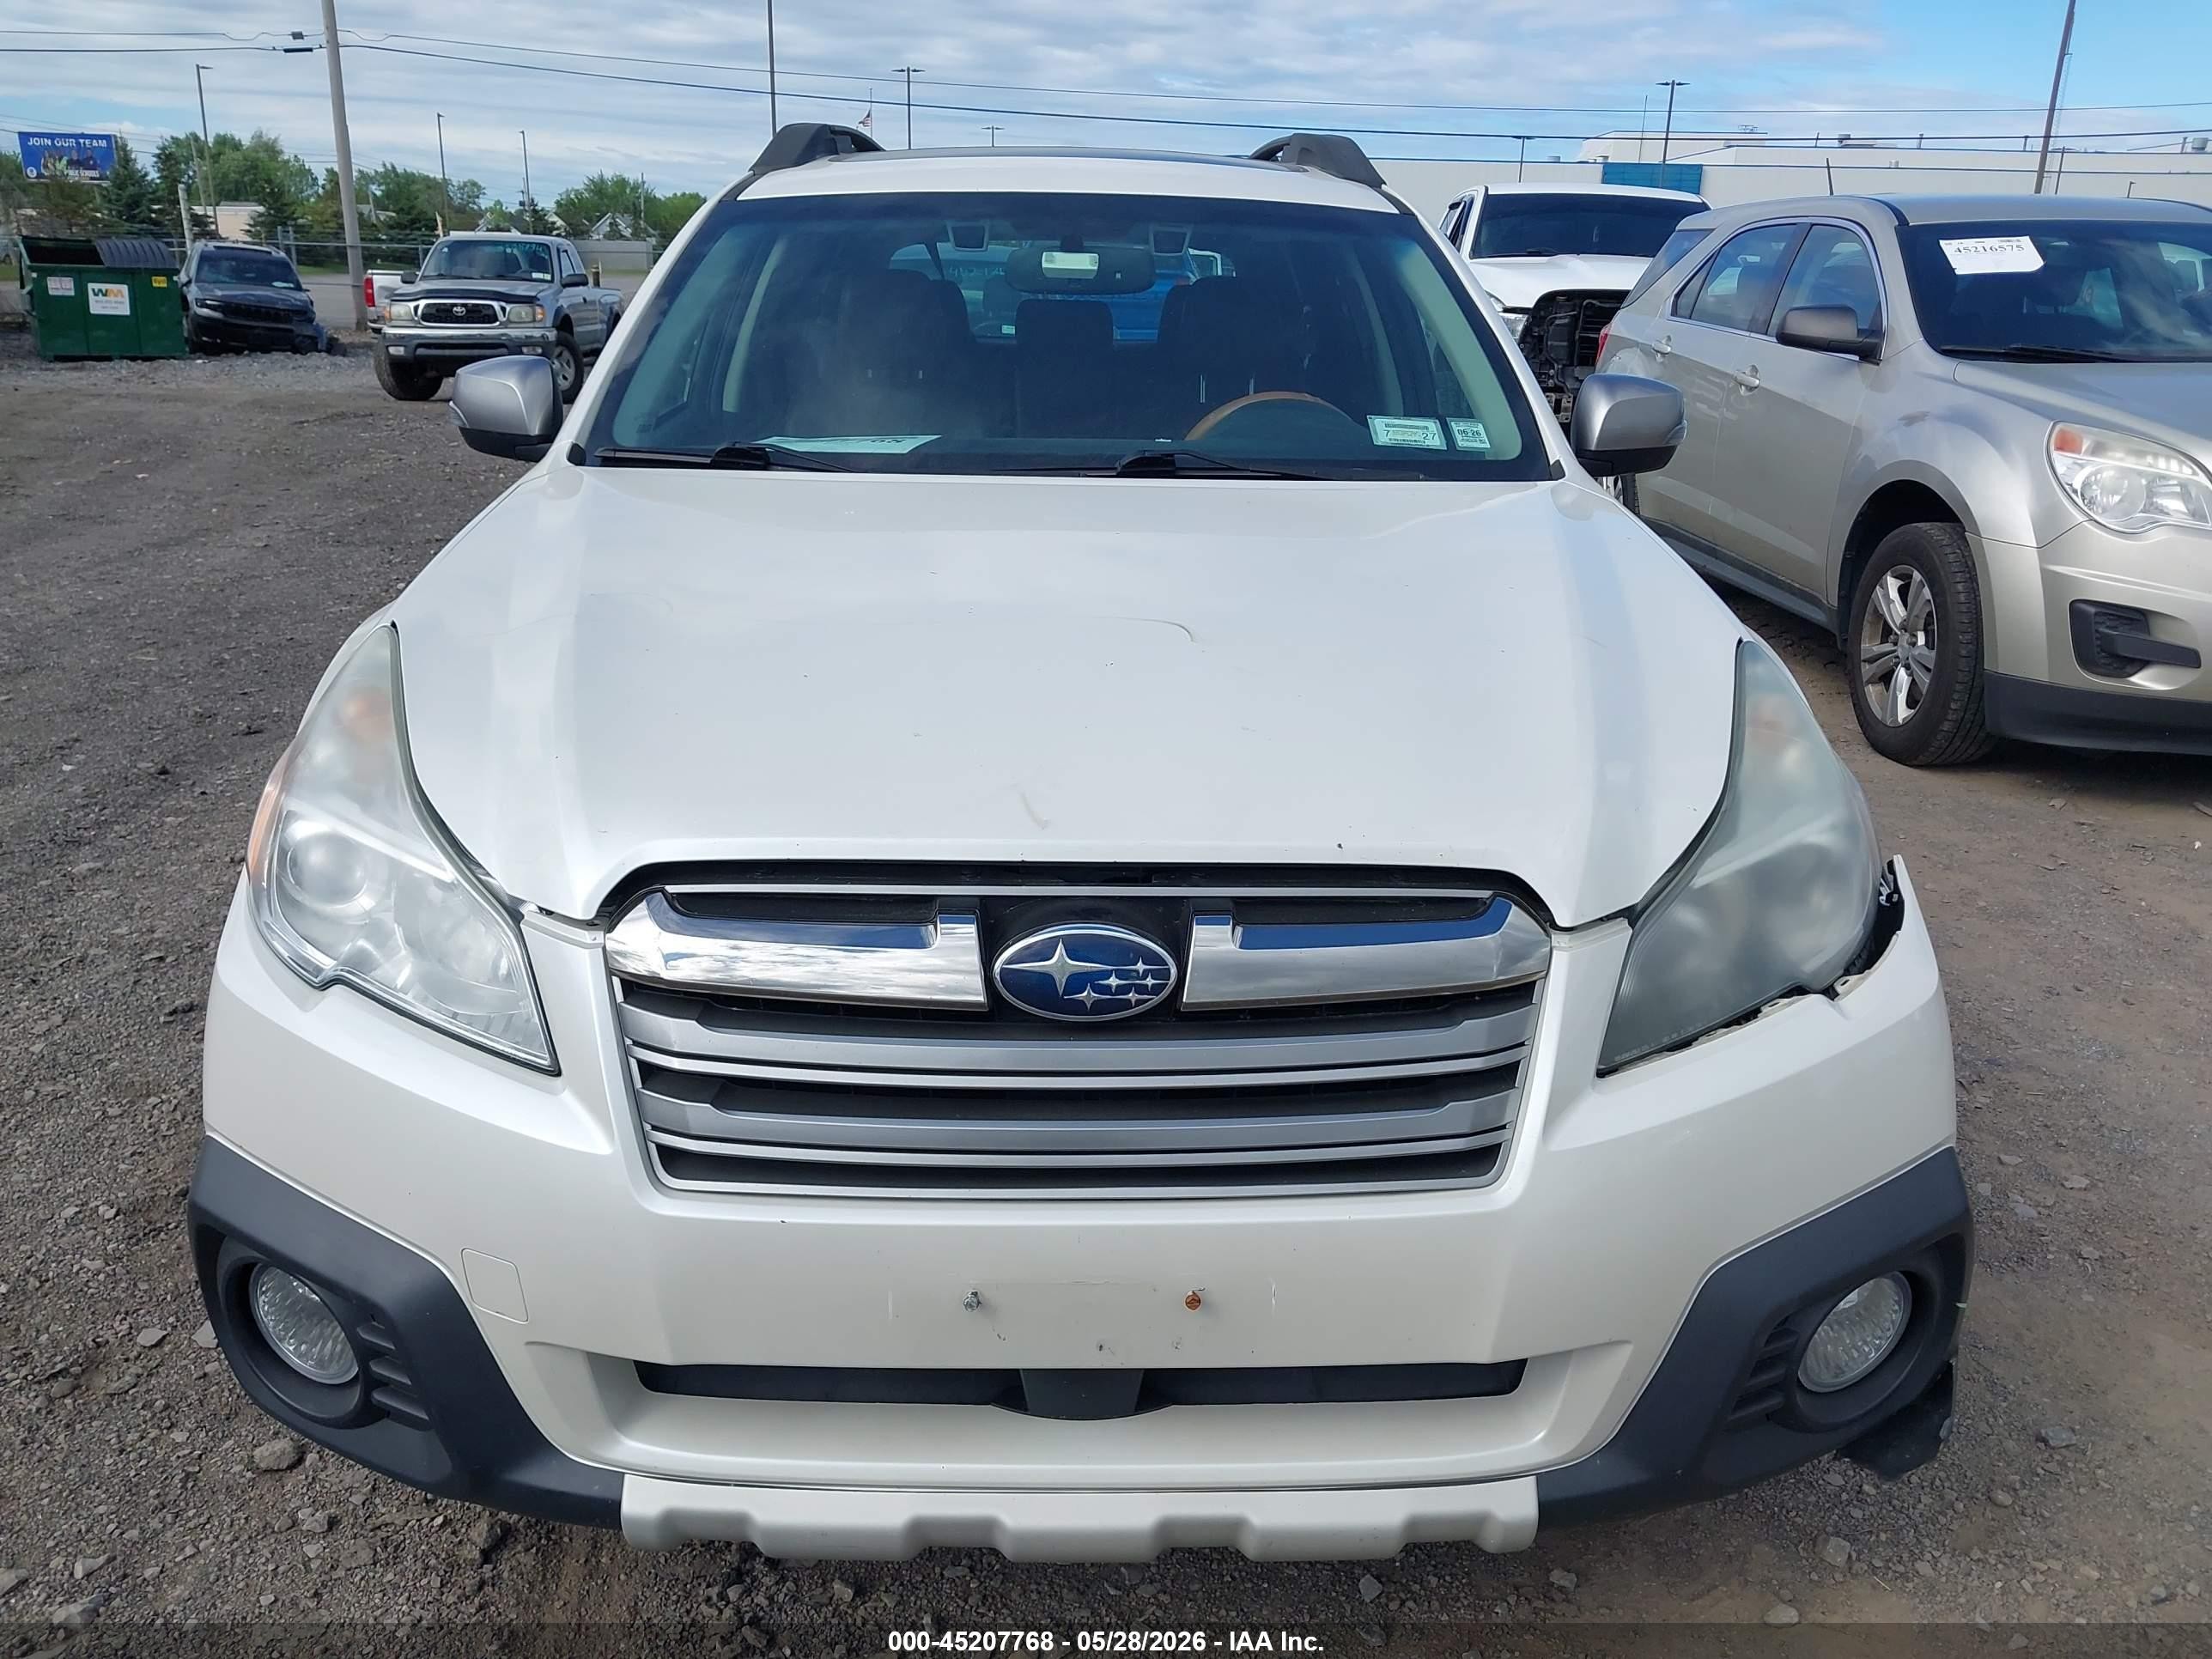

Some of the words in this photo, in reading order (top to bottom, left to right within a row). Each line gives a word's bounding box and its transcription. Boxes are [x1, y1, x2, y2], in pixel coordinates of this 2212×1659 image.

[27, 137, 52, 146] JOIN
[54, 138, 76, 147] OUR
[79, 139, 106, 148] TEAM
[1954, 245, 2025, 253] 45216575
[91, 288, 125, 298] WM
[1422, 432, 1437, 441] 27
